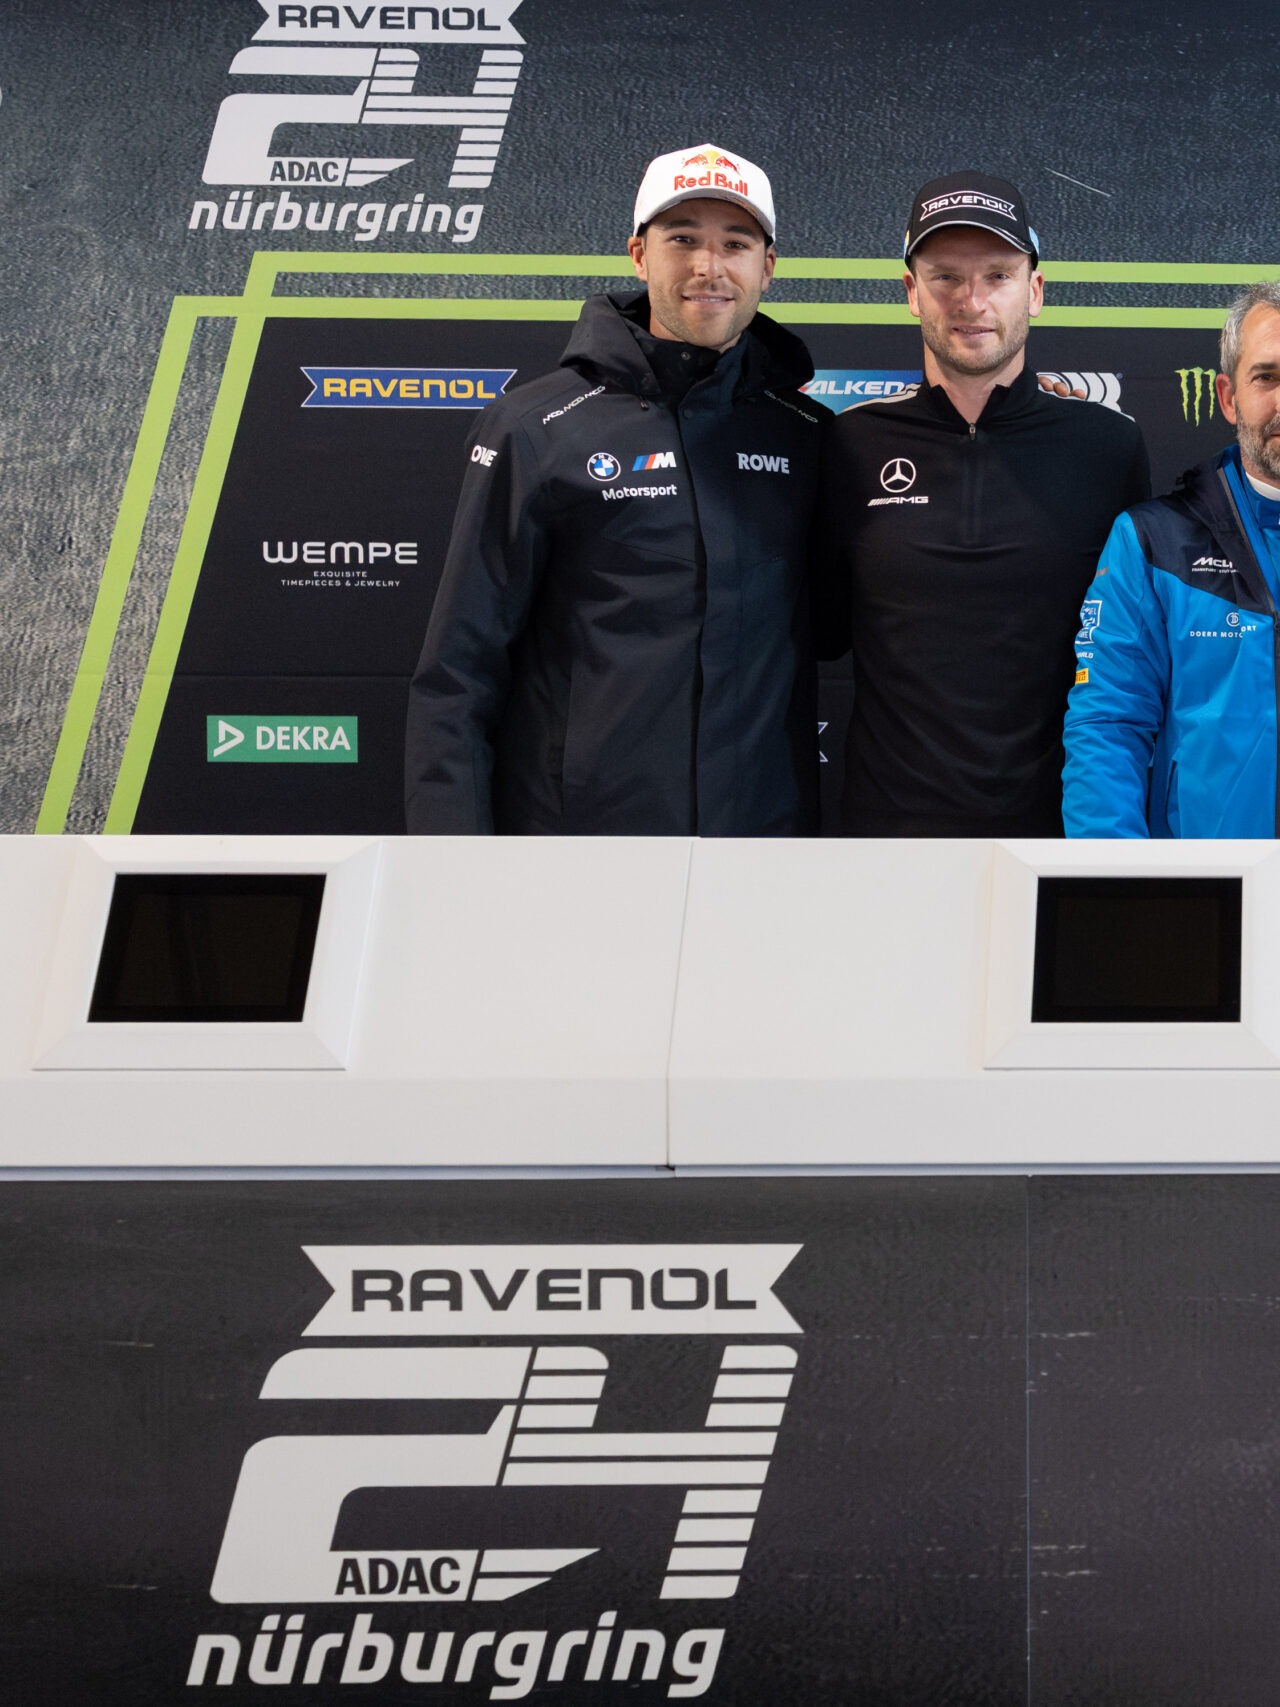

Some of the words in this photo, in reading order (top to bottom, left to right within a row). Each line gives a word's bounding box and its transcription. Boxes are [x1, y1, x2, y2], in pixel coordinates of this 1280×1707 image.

[277, 4, 501, 31] RAVENOL
[269, 160, 339, 183] ADAC
[674, 171, 711, 190] Red
[715, 172, 748, 196] Bull
[928, 195, 1008, 213] RAVENOL
[188, 190, 485, 243] nürburgring
[323, 378, 496, 399] RAVENOL
[802, 380, 905, 396] ALKEN
[736, 452, 790, 475] ROWE
[601, 484, 677, 501] Motorsport
[887, 496, 929, 505] AMG
[262, 541, 418, 564] WEMPE
[281, 579, 342, 587] TIMEPIECES
[313, 570, 368, 578] EXQUISITE
[255, 726, 351, 751] DEKRA
[351, 1268, 757, 1312] RAVENOL
[334, 1557, 461, 1596] ADAC
[186, 1610, 726, 1700] nürburgring
